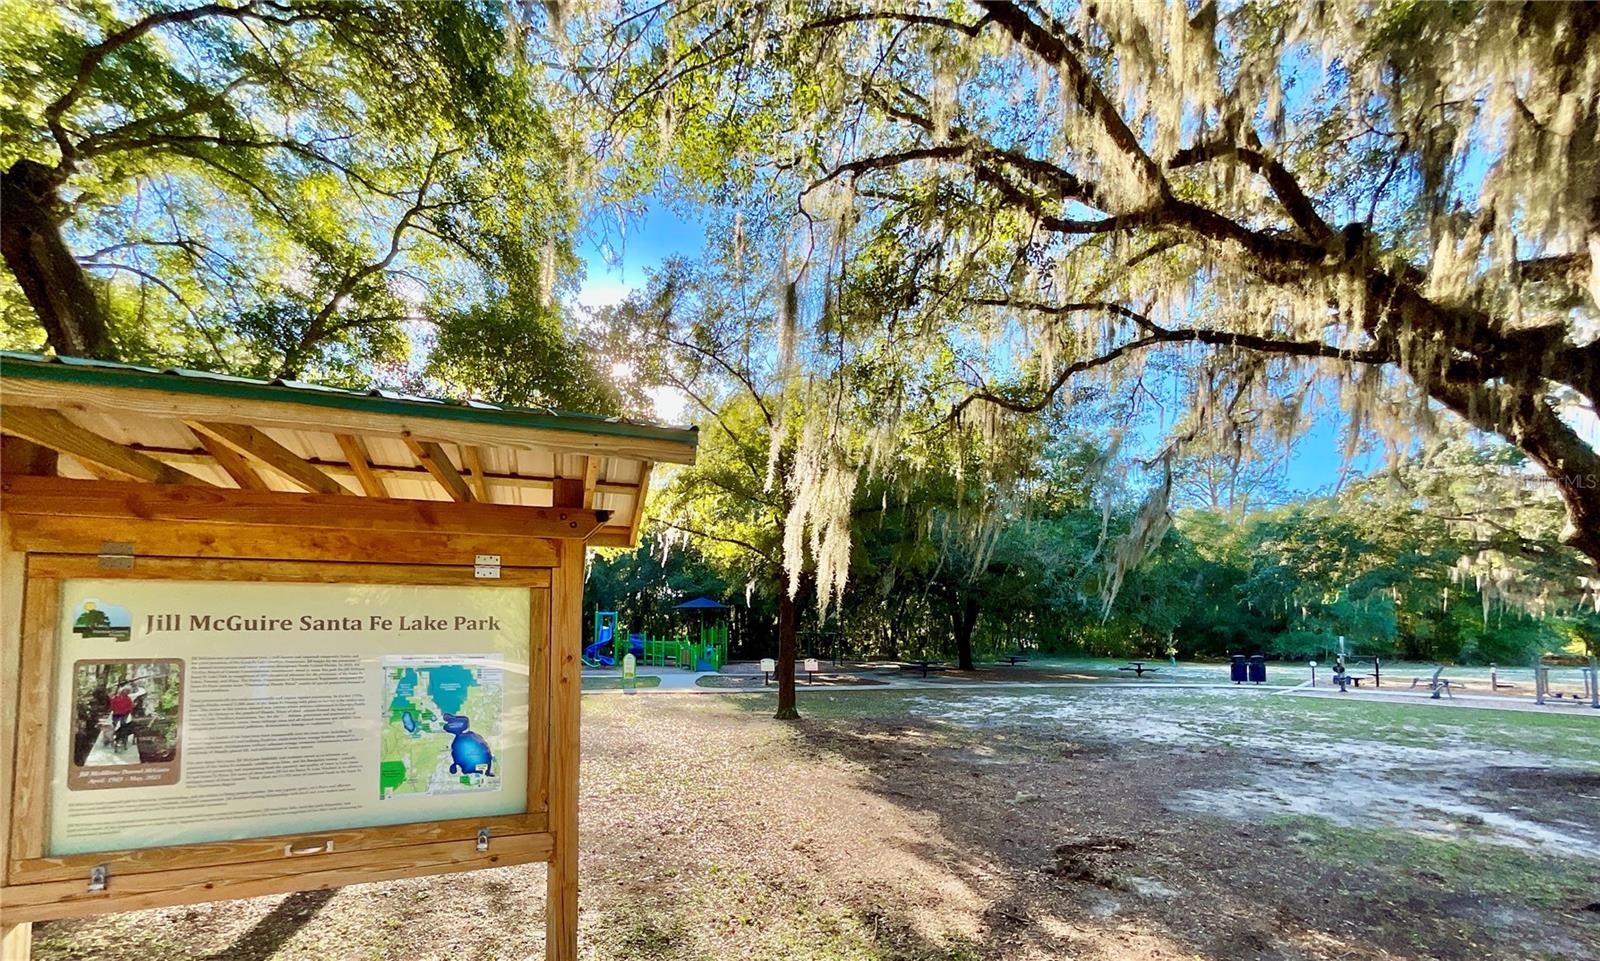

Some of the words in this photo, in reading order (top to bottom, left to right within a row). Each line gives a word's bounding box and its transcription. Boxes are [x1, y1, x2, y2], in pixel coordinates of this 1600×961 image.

[145, 614, 181, 635] Jill
[189, 614, 293, 631] McGuire
[299, 615, 362, 631] Santa
[369, 615, 393, 631] Fe
[399, 615, 448, 631] Lake
[454, 615, 501, 631] Park
